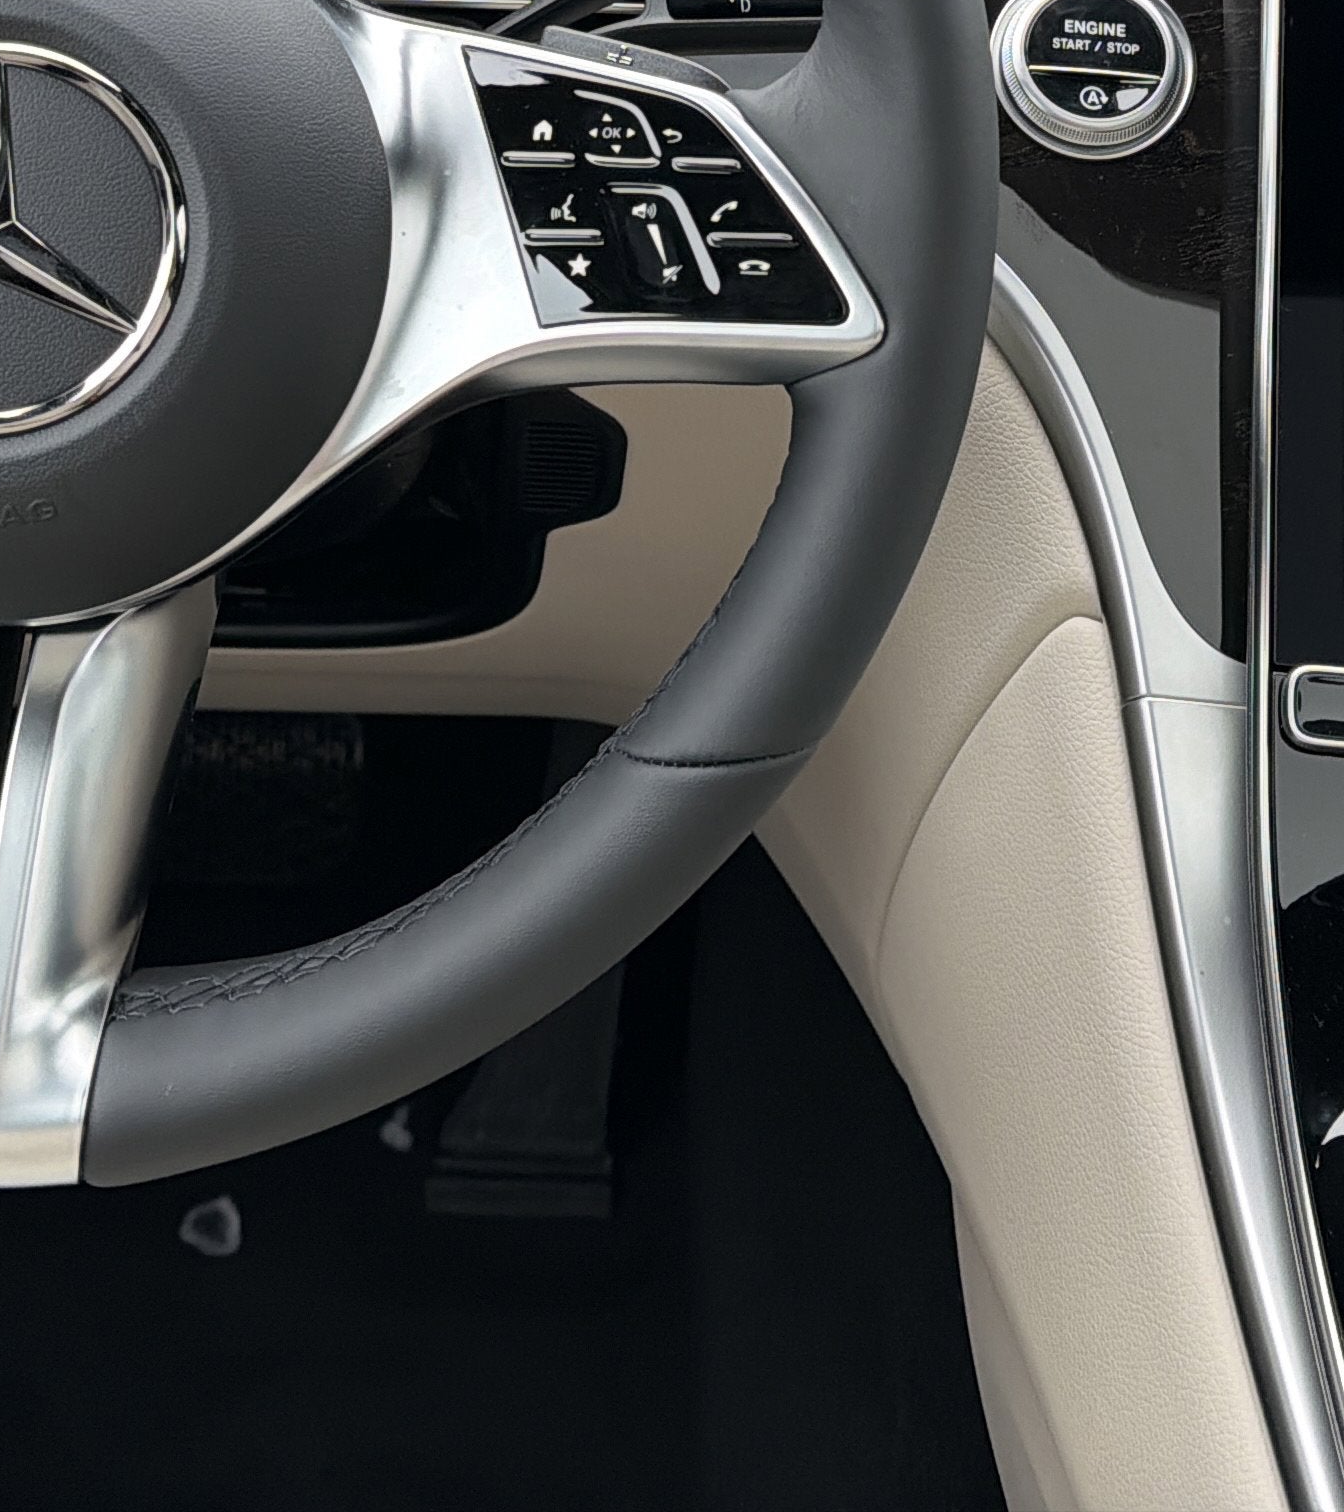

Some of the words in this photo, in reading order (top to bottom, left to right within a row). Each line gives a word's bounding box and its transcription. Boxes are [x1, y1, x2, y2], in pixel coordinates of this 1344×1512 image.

[1064, 19, 1127, 38] ENGINE
[1052, 38, 1091, 52] START
[1106, 42, 1140, 55] STOP
[602, 126, 622, 140] OK
